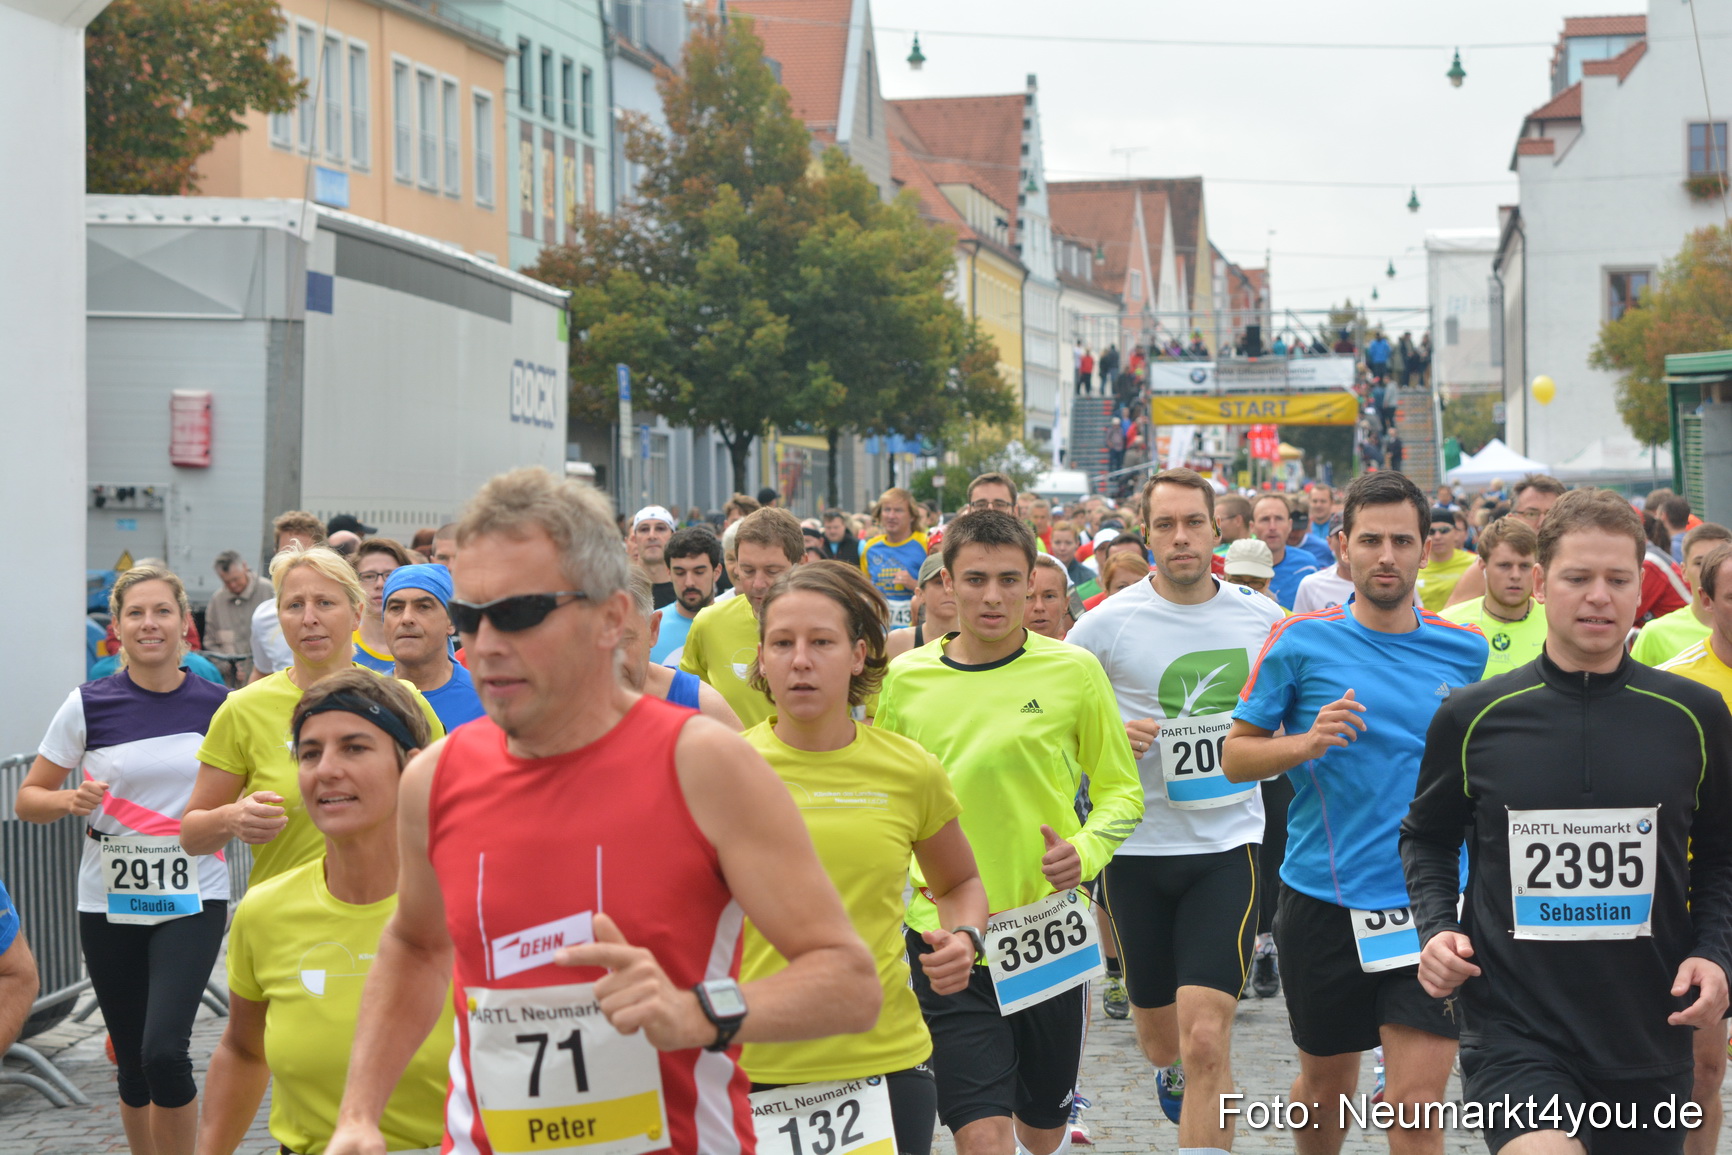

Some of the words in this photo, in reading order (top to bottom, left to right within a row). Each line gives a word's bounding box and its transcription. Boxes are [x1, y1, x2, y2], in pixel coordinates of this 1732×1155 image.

[510, 359, 556, 429] BOCK
[1219, 400, 1289, 418] START
[1161, 726, 1197, 738] PARTL
[1198, 721, 1234, 734] Neumar
[1512, 823, 1559, 835] PARTL
[1563, 822, 1631, 835] Neumarkt
[102, 844, 133, 854] PARTL
[135, 845, 181, 854] Neumarkt
[111, 857, 189, 890] 2918
[1525, 841, 1644, 890] 2395
[1517, 886, 1523, 895] B
[129, 898, 176, 912] Claudia
[1024, 899, 1068, 926] Neumarkt
[1540, 902, 1631, 921] Sebastian
[519, 931, 565, 959] DEHN
[997, 910, 1088, 972] 3363
[521, 1000, 601, 1022] Neumark
[515, 1028, 589, 1098] 71
[794, 1080, 862, 1109] Neumarkt
[528, 1116, 597, 1143] Peter
[777, 1098, 864, 1155] 132
